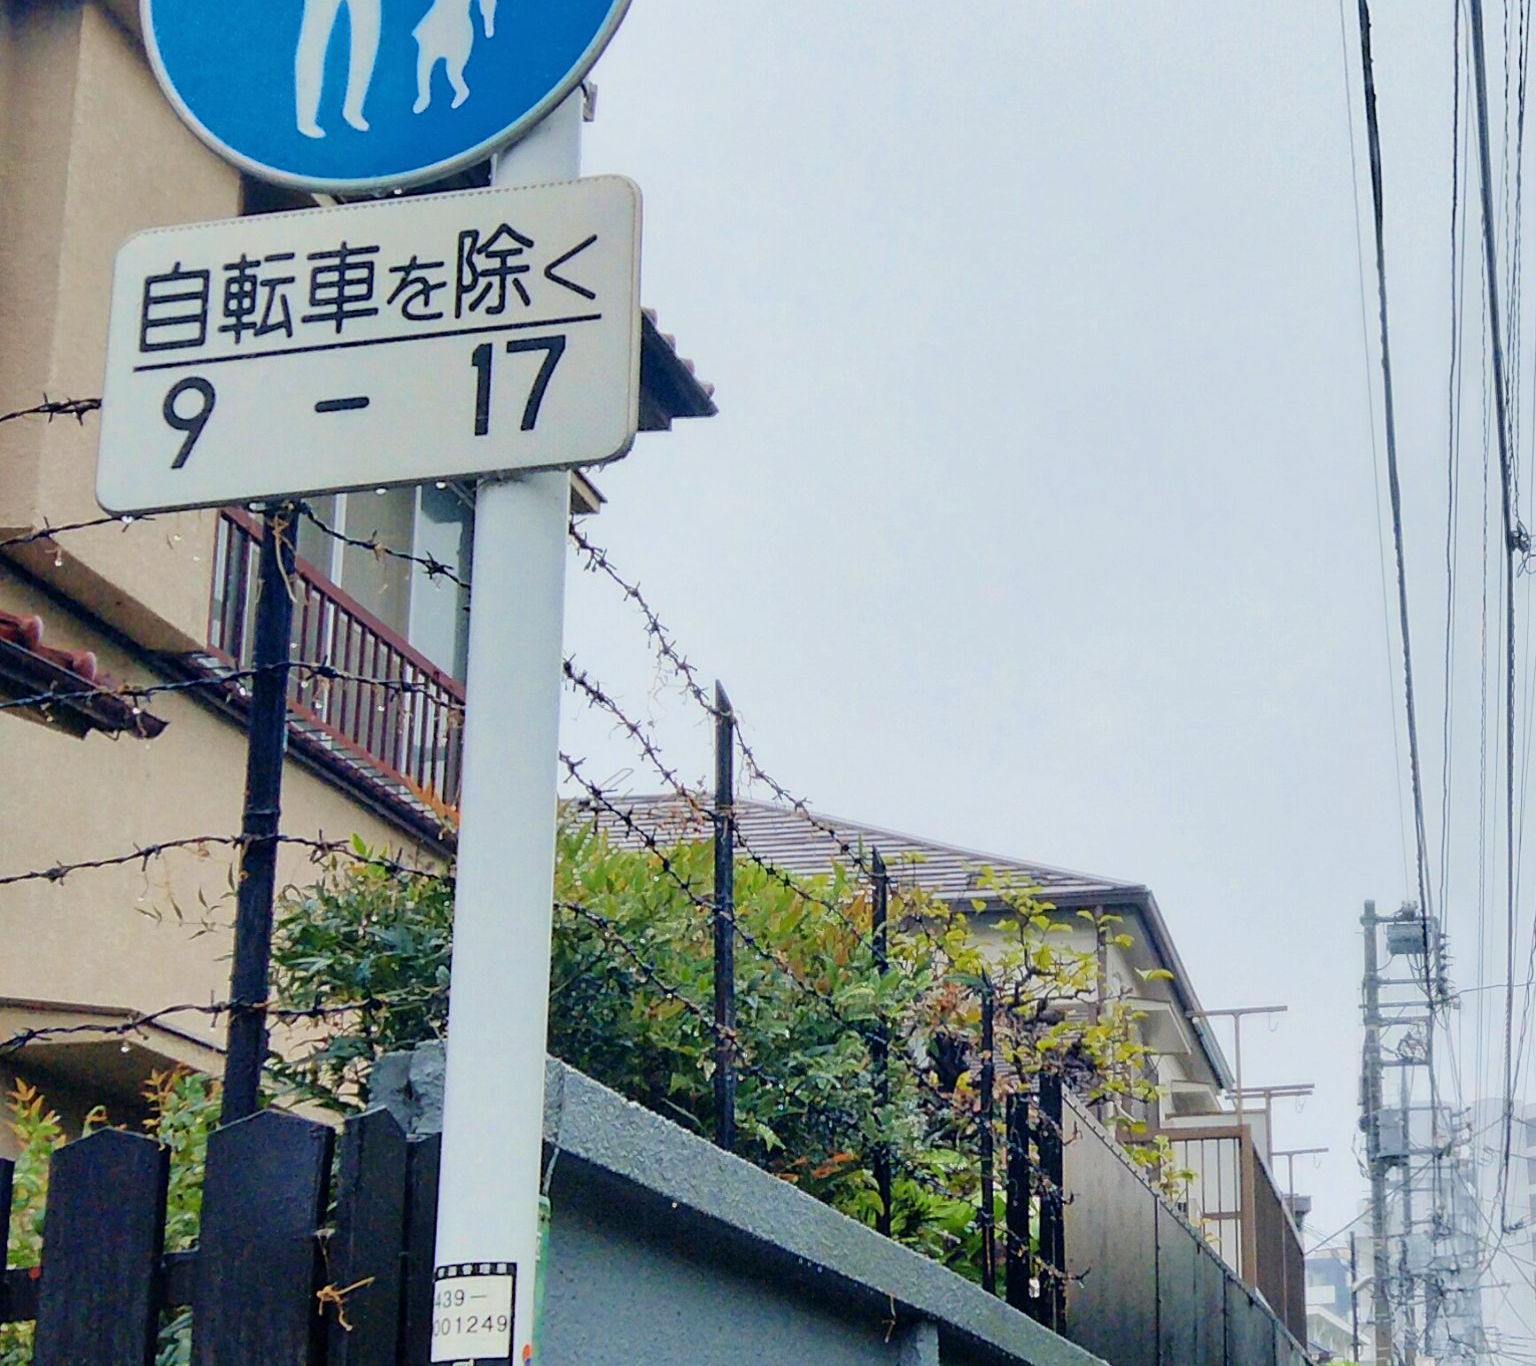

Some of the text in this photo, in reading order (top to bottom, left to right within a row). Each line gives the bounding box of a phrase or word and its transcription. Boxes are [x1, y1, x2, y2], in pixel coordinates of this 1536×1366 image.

[139, 223, 598, 353] 自転車を除く
[162, 376, 216, 469] 9
[471, 334, 567, 436] 17
